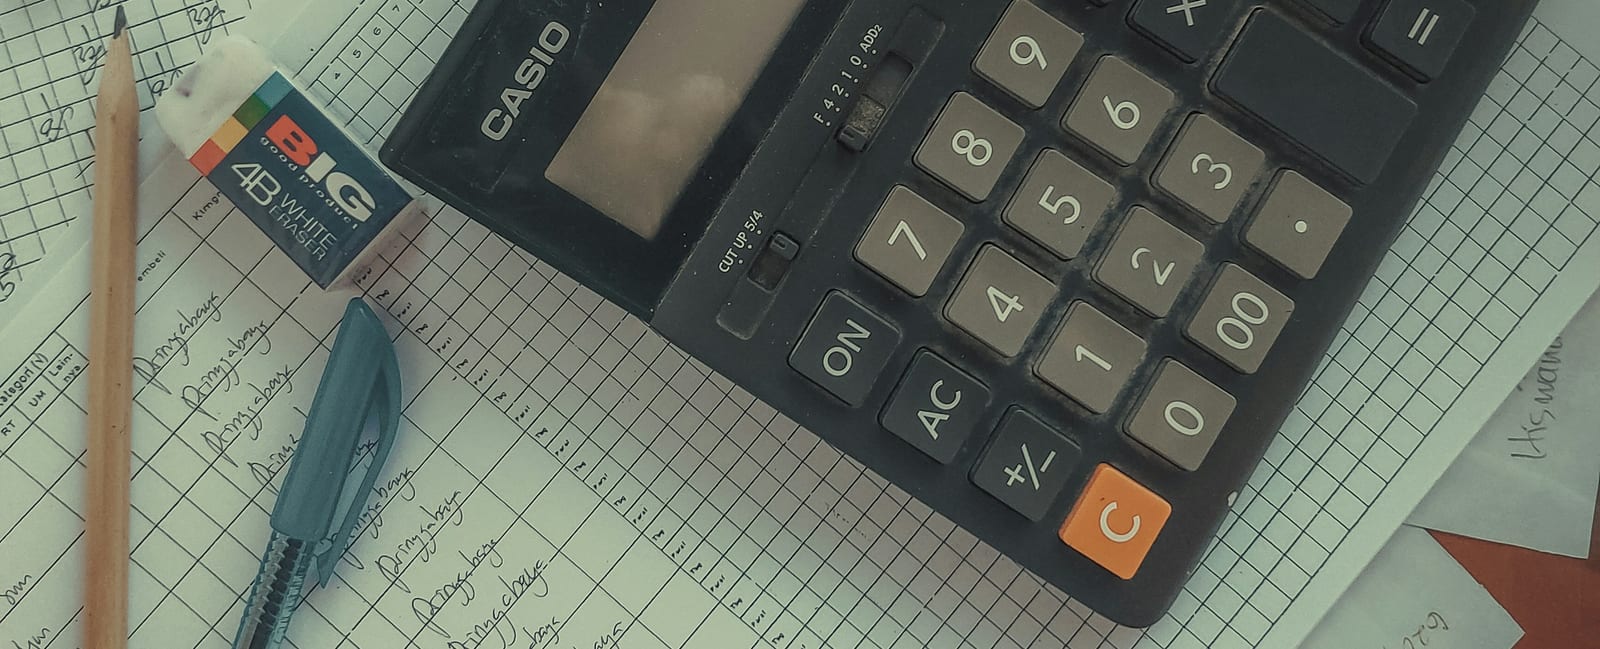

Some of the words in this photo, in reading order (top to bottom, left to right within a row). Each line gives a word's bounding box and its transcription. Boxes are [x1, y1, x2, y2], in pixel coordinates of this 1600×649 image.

[352, 48, 362, 59] 5
[372, 26, 382, 36] 6
[391, 4, 401, 13] 7
[1010, 36, 1047, 70] 9
[480, 21, 570, 142] CASIO
[813, 112, 824, 124] F
[823, 98, 834, 110] 4
[831, 83, 845, 96] 2
[841, 70, 853, 79] 1
[849, 55, 862, 66] 0
[1102, 95, 1140, 130] 6
[265, 114, 376, 222] BIG
[951, 129, 993, 166] 8
[231, 163, 282, 206] 4B
[259, 136, 299, 172] good
[299, 174, 360, 230] product
[1191, 153, 1232, 190] 3
[280, 192, 337, 250] WHITE
[1038, 185, 1081, 226] 5
[268, 204, 327, 261] ERASER
[718, 247, 738, 273] CUT
[733, 231, 747, 249] UP
[744, 210, 763, 232] 5/4
[887, 220, 927, 261] 7
[137, 249, 167, 282] embeli
[1131, 247, 1175, 286] 2
[987, 286, 1024, 323] 4
[1216, 292, 1269, 350] 00
[822, 318, 871, 377] ON
[1075, 345, 1113, 379] 1
[1, 419, 16, 436] RT
[917, 379, 961, 441] AC
[1164, 401, 1204, 437] 0
[1003, 443, 1056, 491] +/-
[1100, 501, 1141, 542] C
